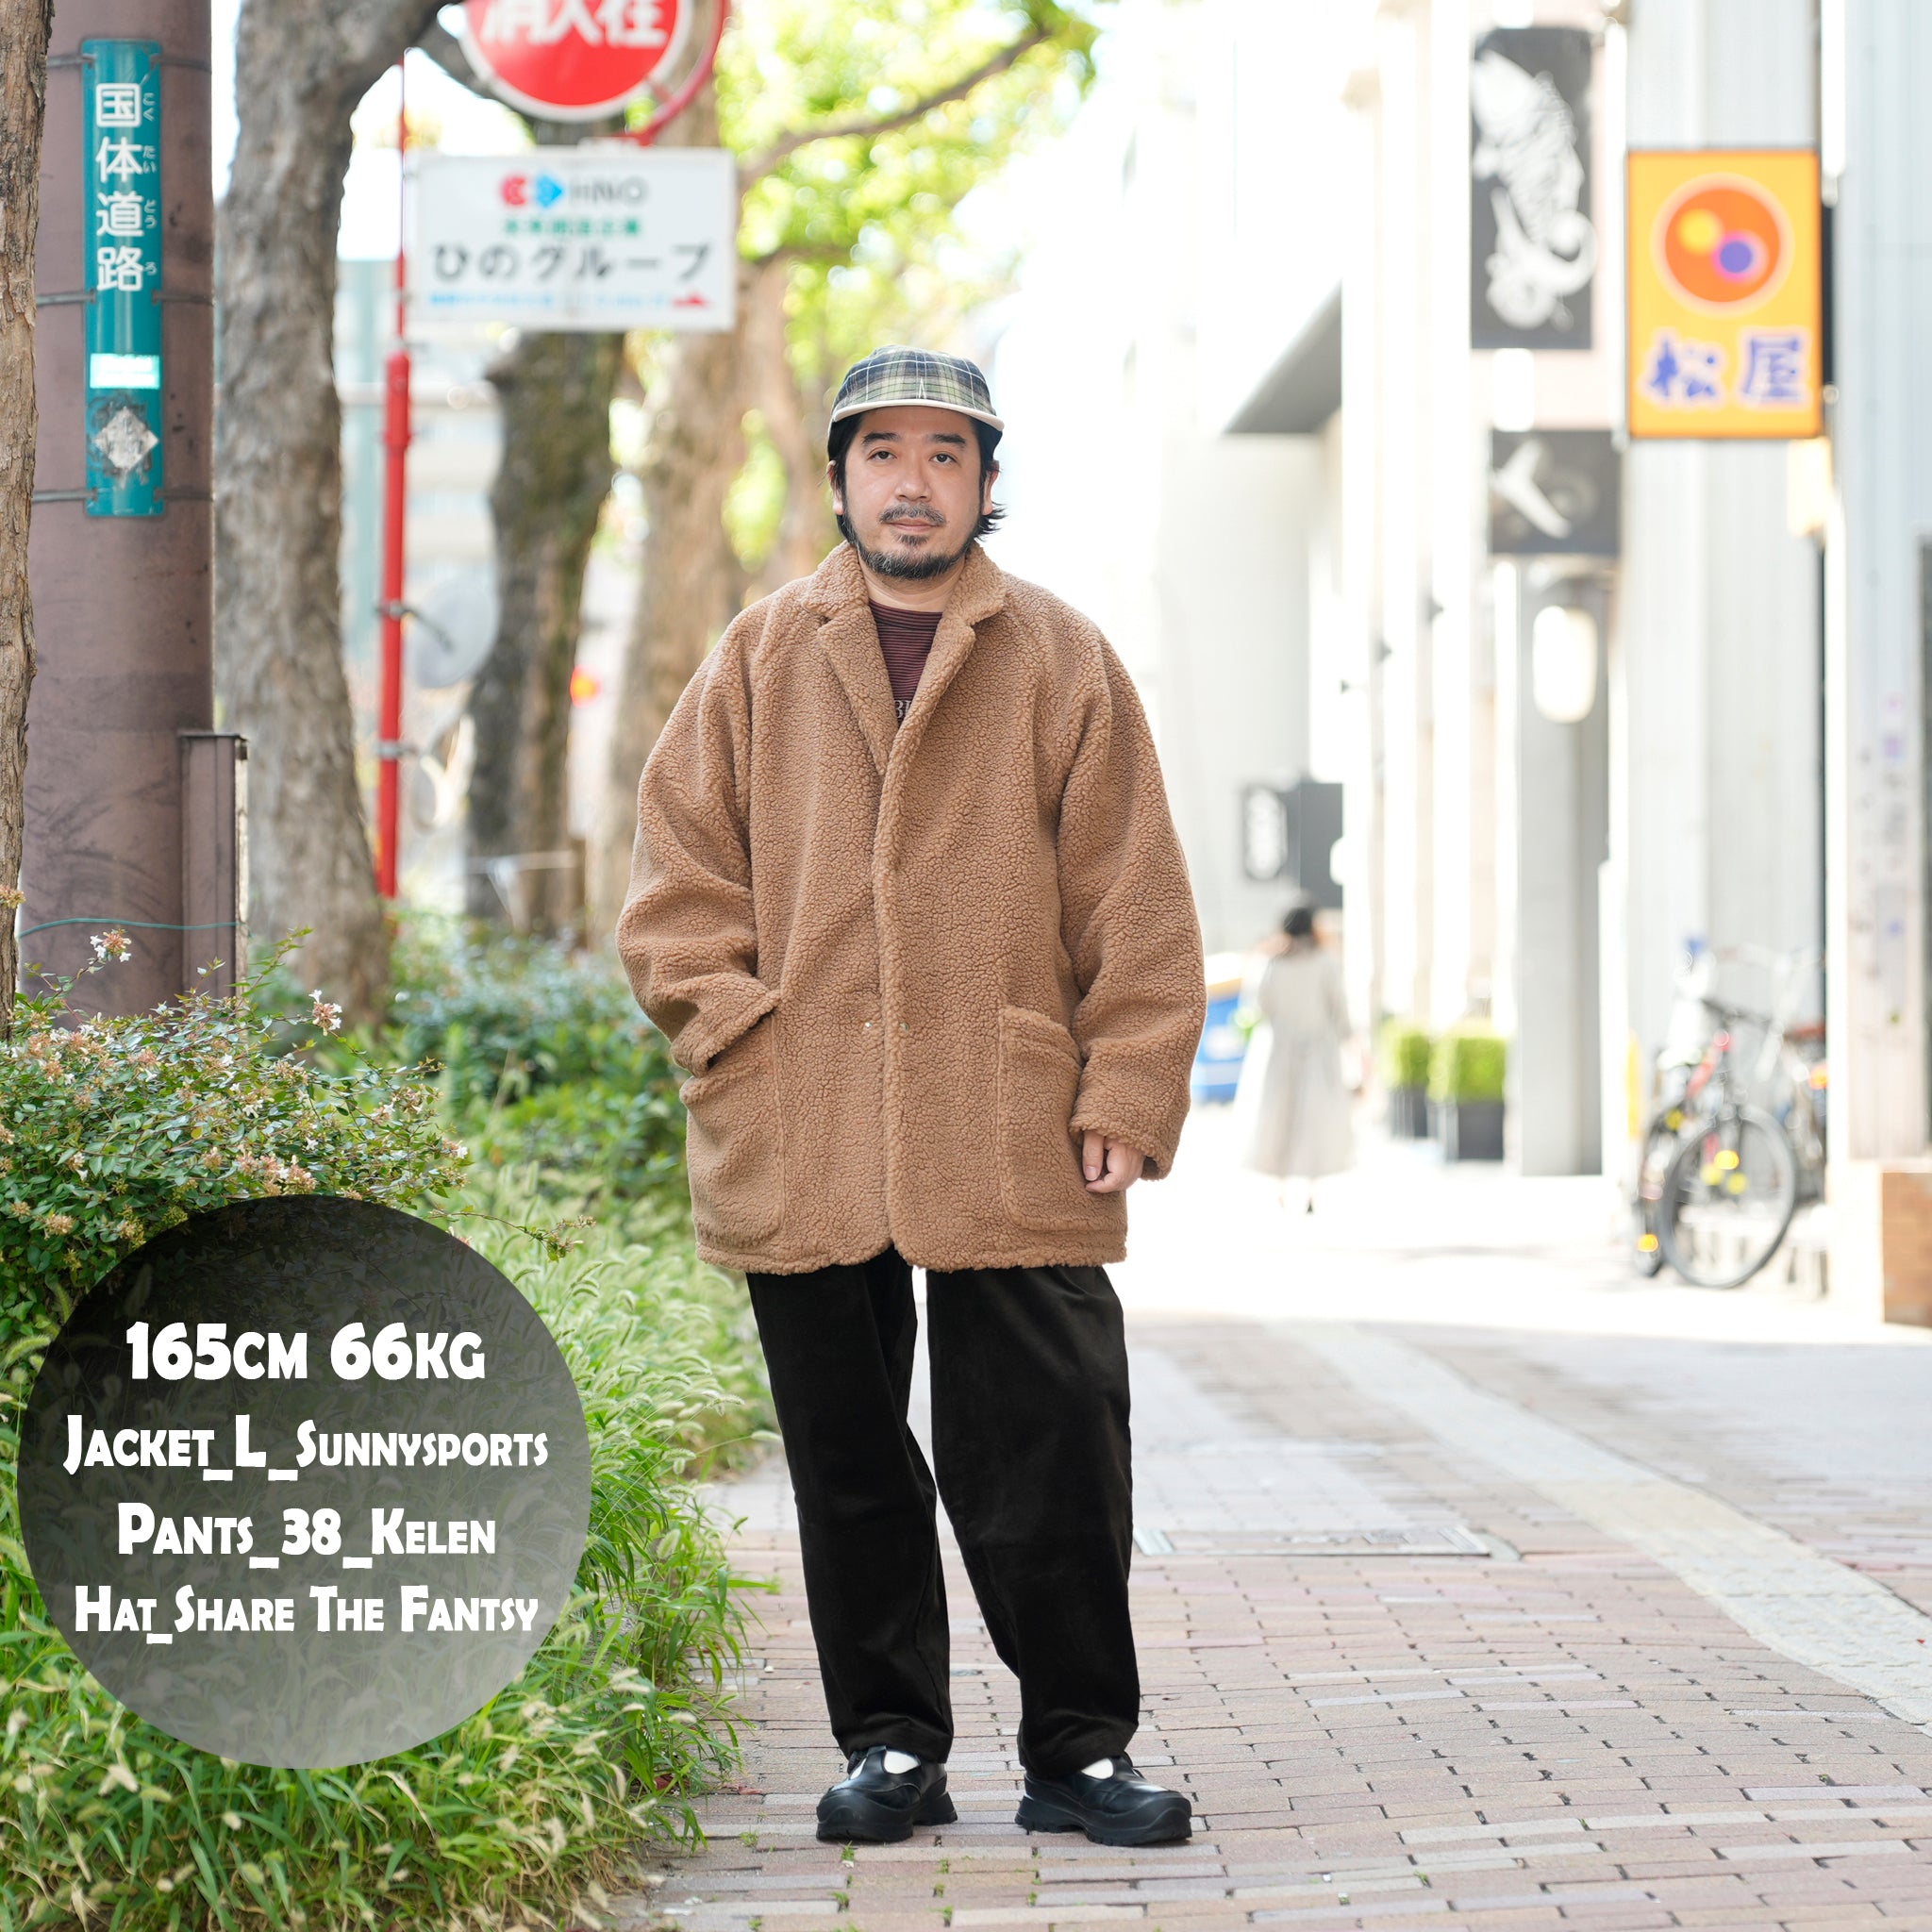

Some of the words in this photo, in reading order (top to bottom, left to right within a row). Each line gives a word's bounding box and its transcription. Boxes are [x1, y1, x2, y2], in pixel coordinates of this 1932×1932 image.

[95, 82, 143, 291] 国体道路
[1647, 335, 1803, 404] 松屋
